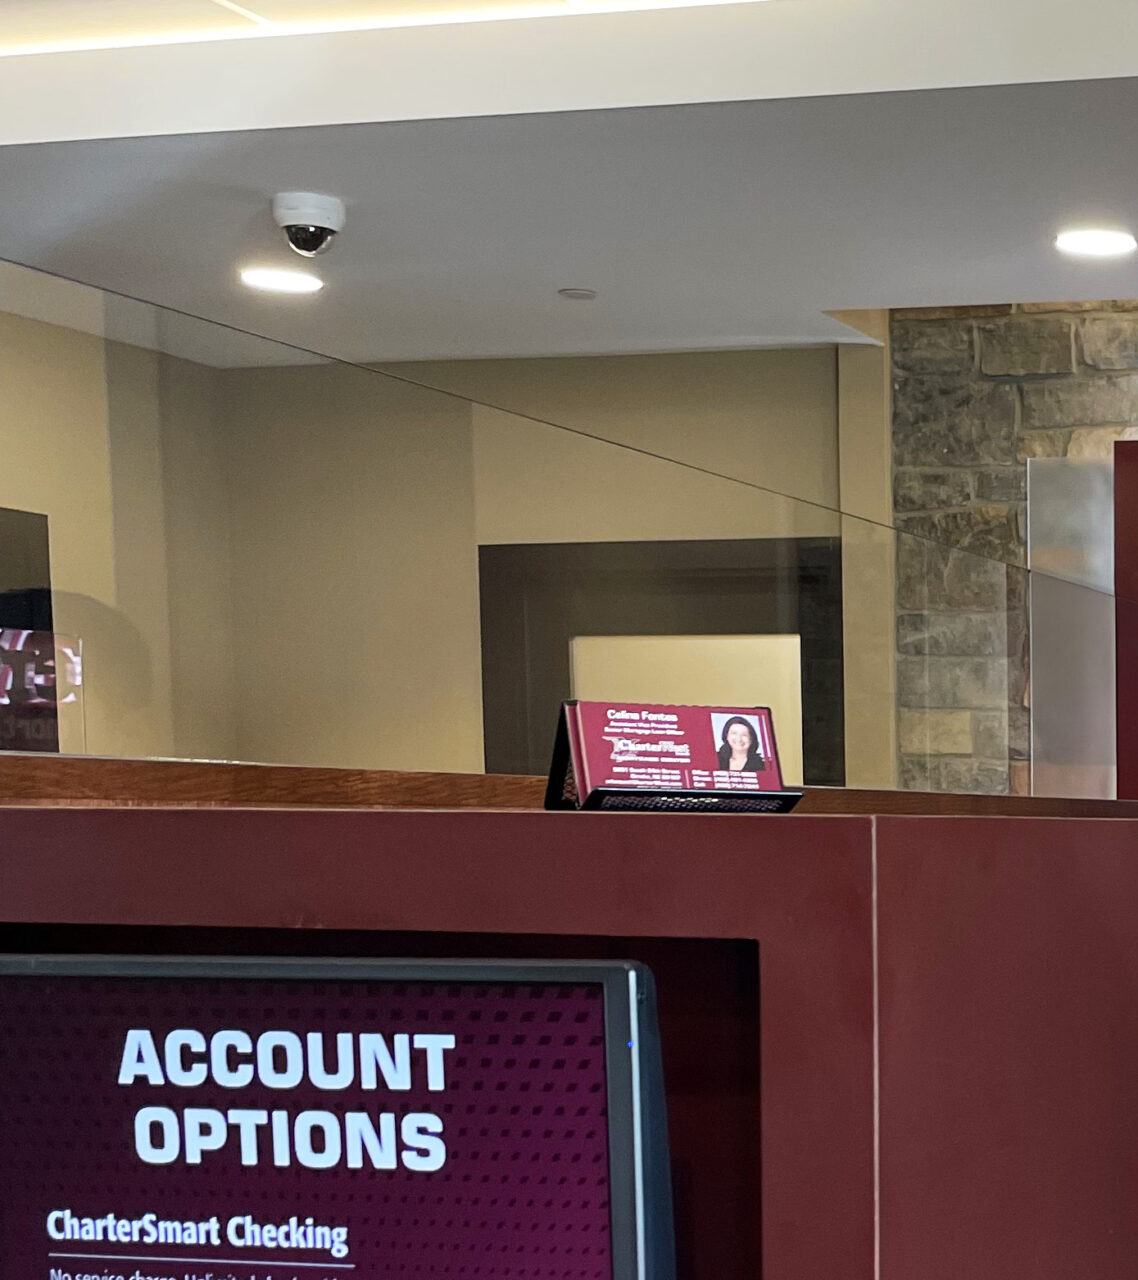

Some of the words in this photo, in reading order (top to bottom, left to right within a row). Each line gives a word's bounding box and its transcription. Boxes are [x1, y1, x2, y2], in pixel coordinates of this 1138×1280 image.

[117, 1028, 456, 1092] ACCOUNT
[133, 1105, 447, 1172] OPTIONS
[46, 1208, 222, 1247] CharterSmart
[226, 1214, 350, 1259] Checking
